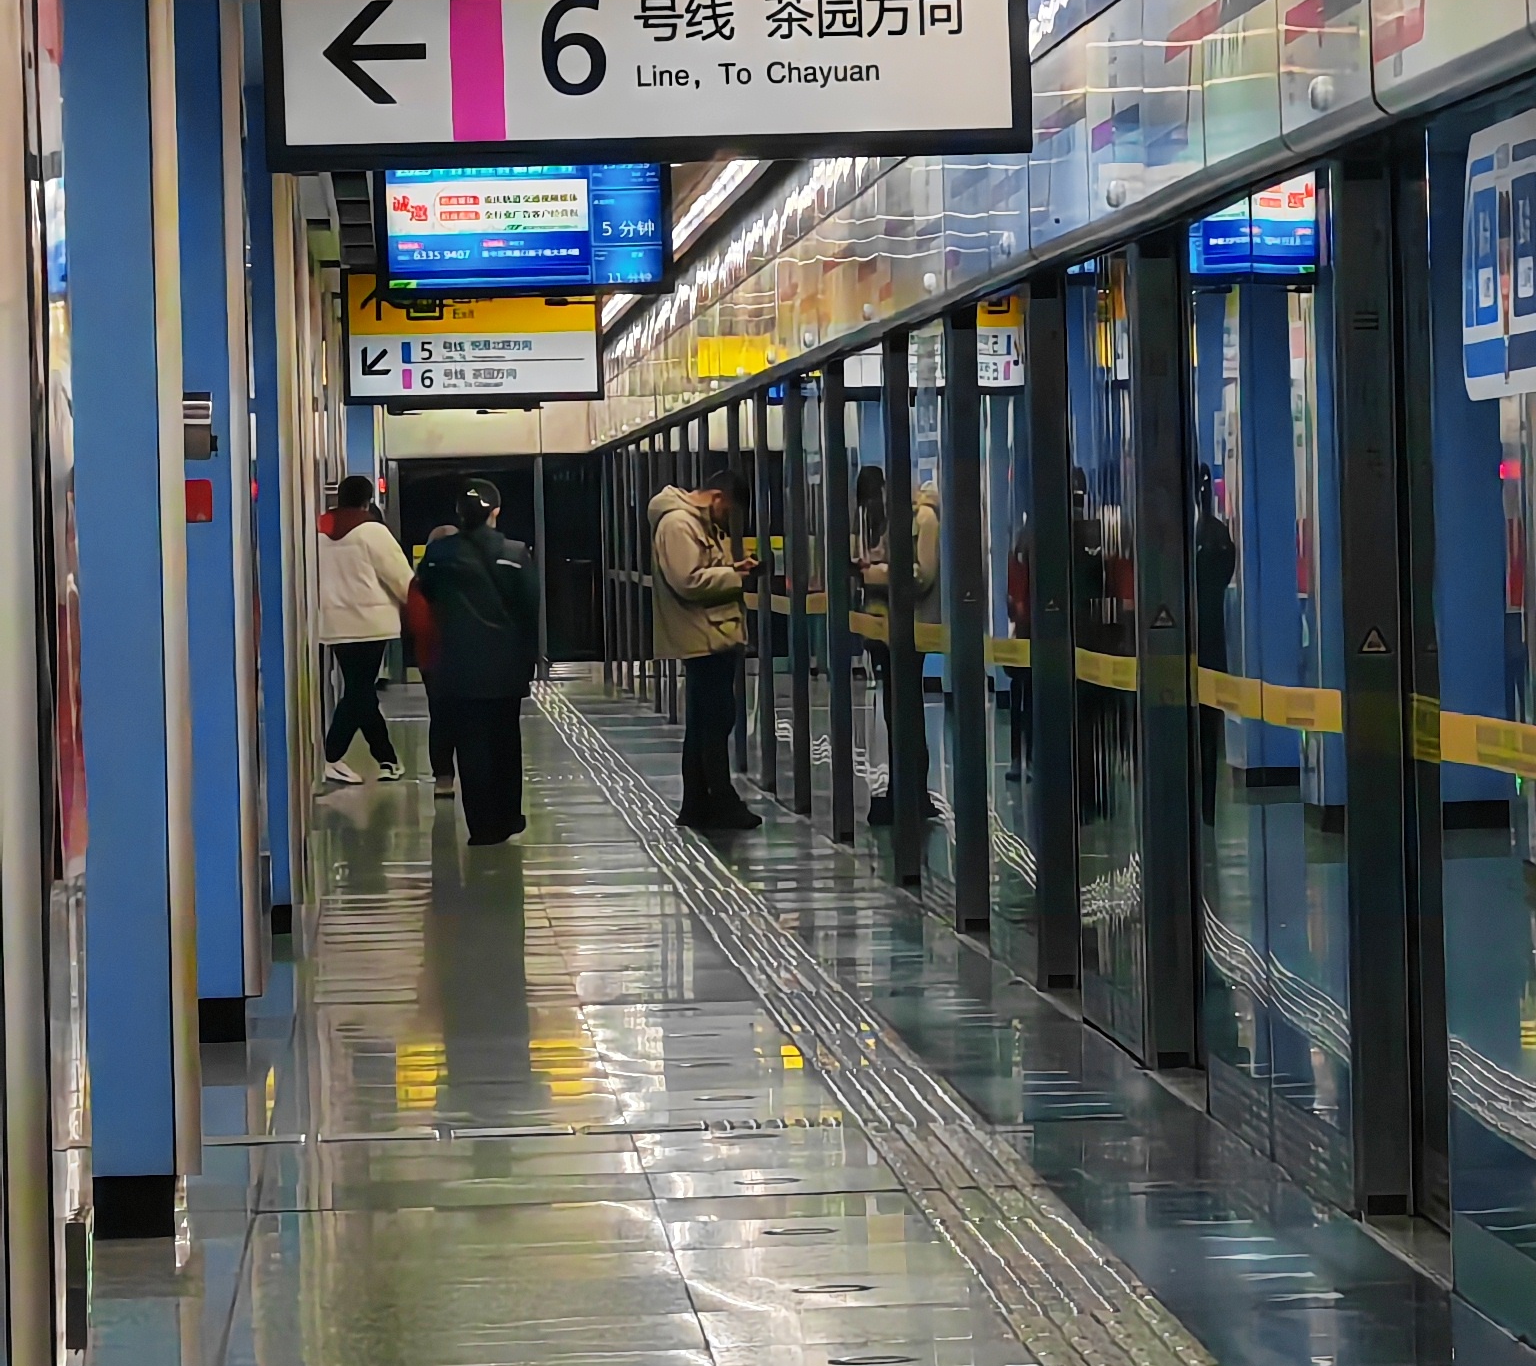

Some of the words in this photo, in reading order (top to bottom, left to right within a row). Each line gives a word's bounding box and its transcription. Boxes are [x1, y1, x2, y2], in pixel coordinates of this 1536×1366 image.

[637, 64, 702, 90] Line,
[718, 62, 752, 85] To
[767, 61, 881, 88] Chayuan
[602, 221, 612, 236] 5
[619, 219, 655, 237] 分钟
[421, 341, 433, 360] 5
[421, 369, 434, 388] 6
